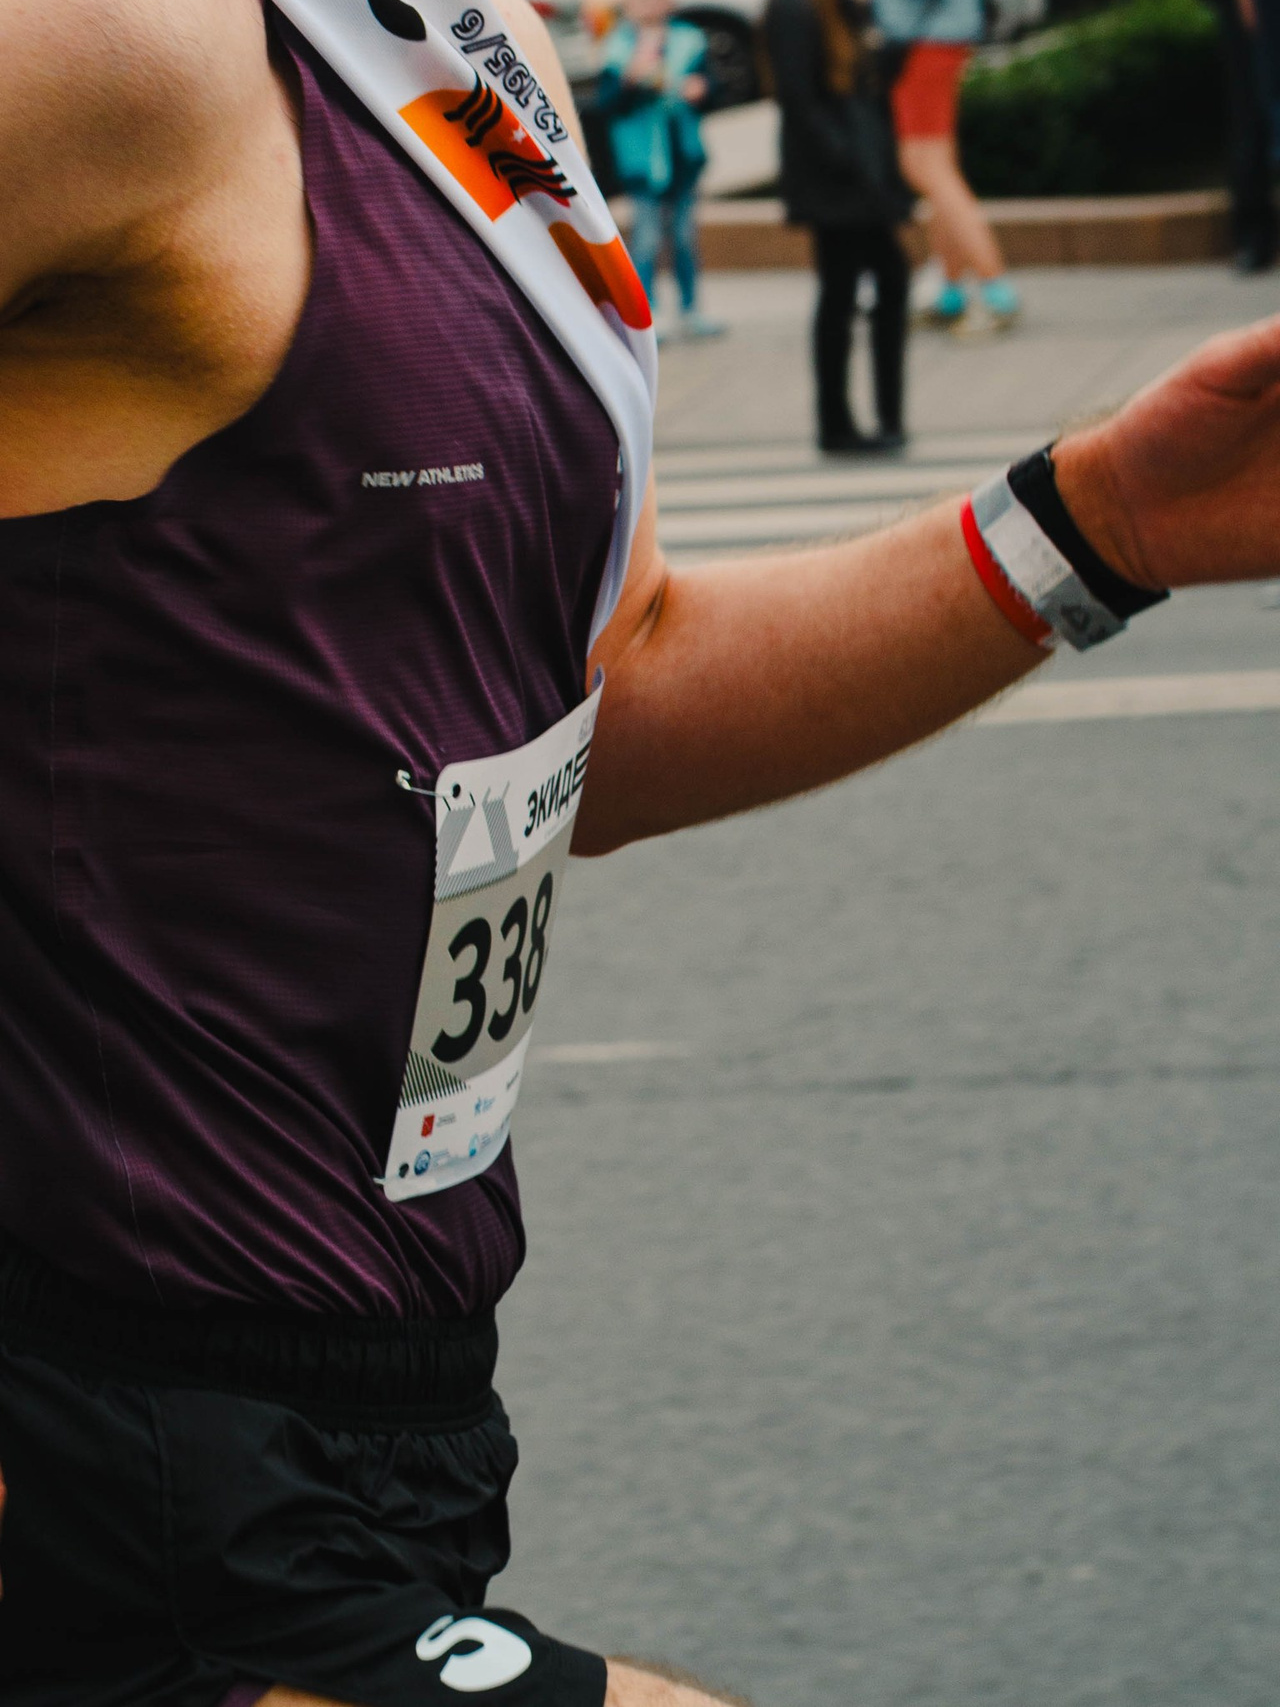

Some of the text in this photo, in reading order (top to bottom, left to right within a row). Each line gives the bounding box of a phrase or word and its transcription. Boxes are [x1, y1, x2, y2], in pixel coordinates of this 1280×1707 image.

[361, 461, 485, 488] NEW ATHLETICS
[430, 871, 553, 1064] 338
